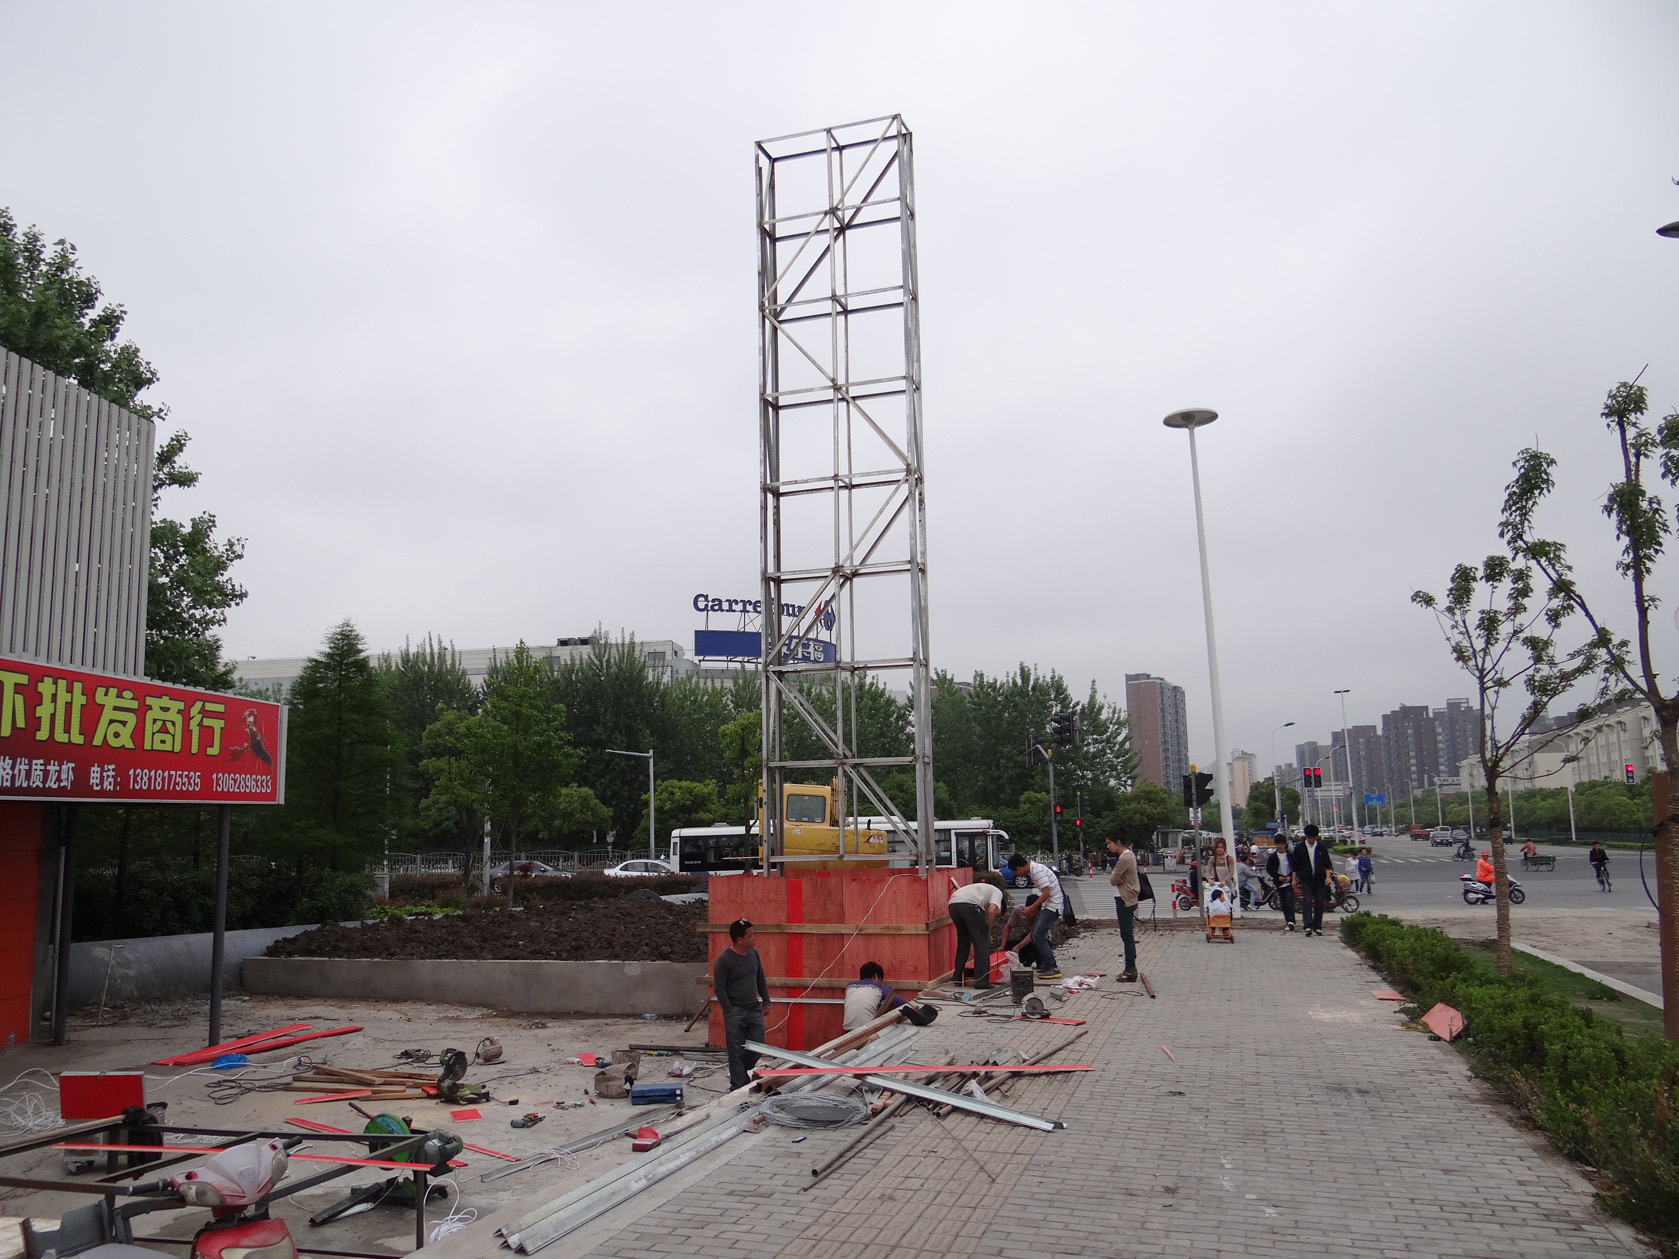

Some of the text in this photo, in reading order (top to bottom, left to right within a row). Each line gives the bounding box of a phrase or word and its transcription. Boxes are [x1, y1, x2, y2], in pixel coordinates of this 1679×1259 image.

[693, 593, 806, 618] Carreur
[0, 755, 76, 790] 格优质龙虾
[128, 768, 201, 791] 13818175535
[212, 772, 272, 793] 13062896333
